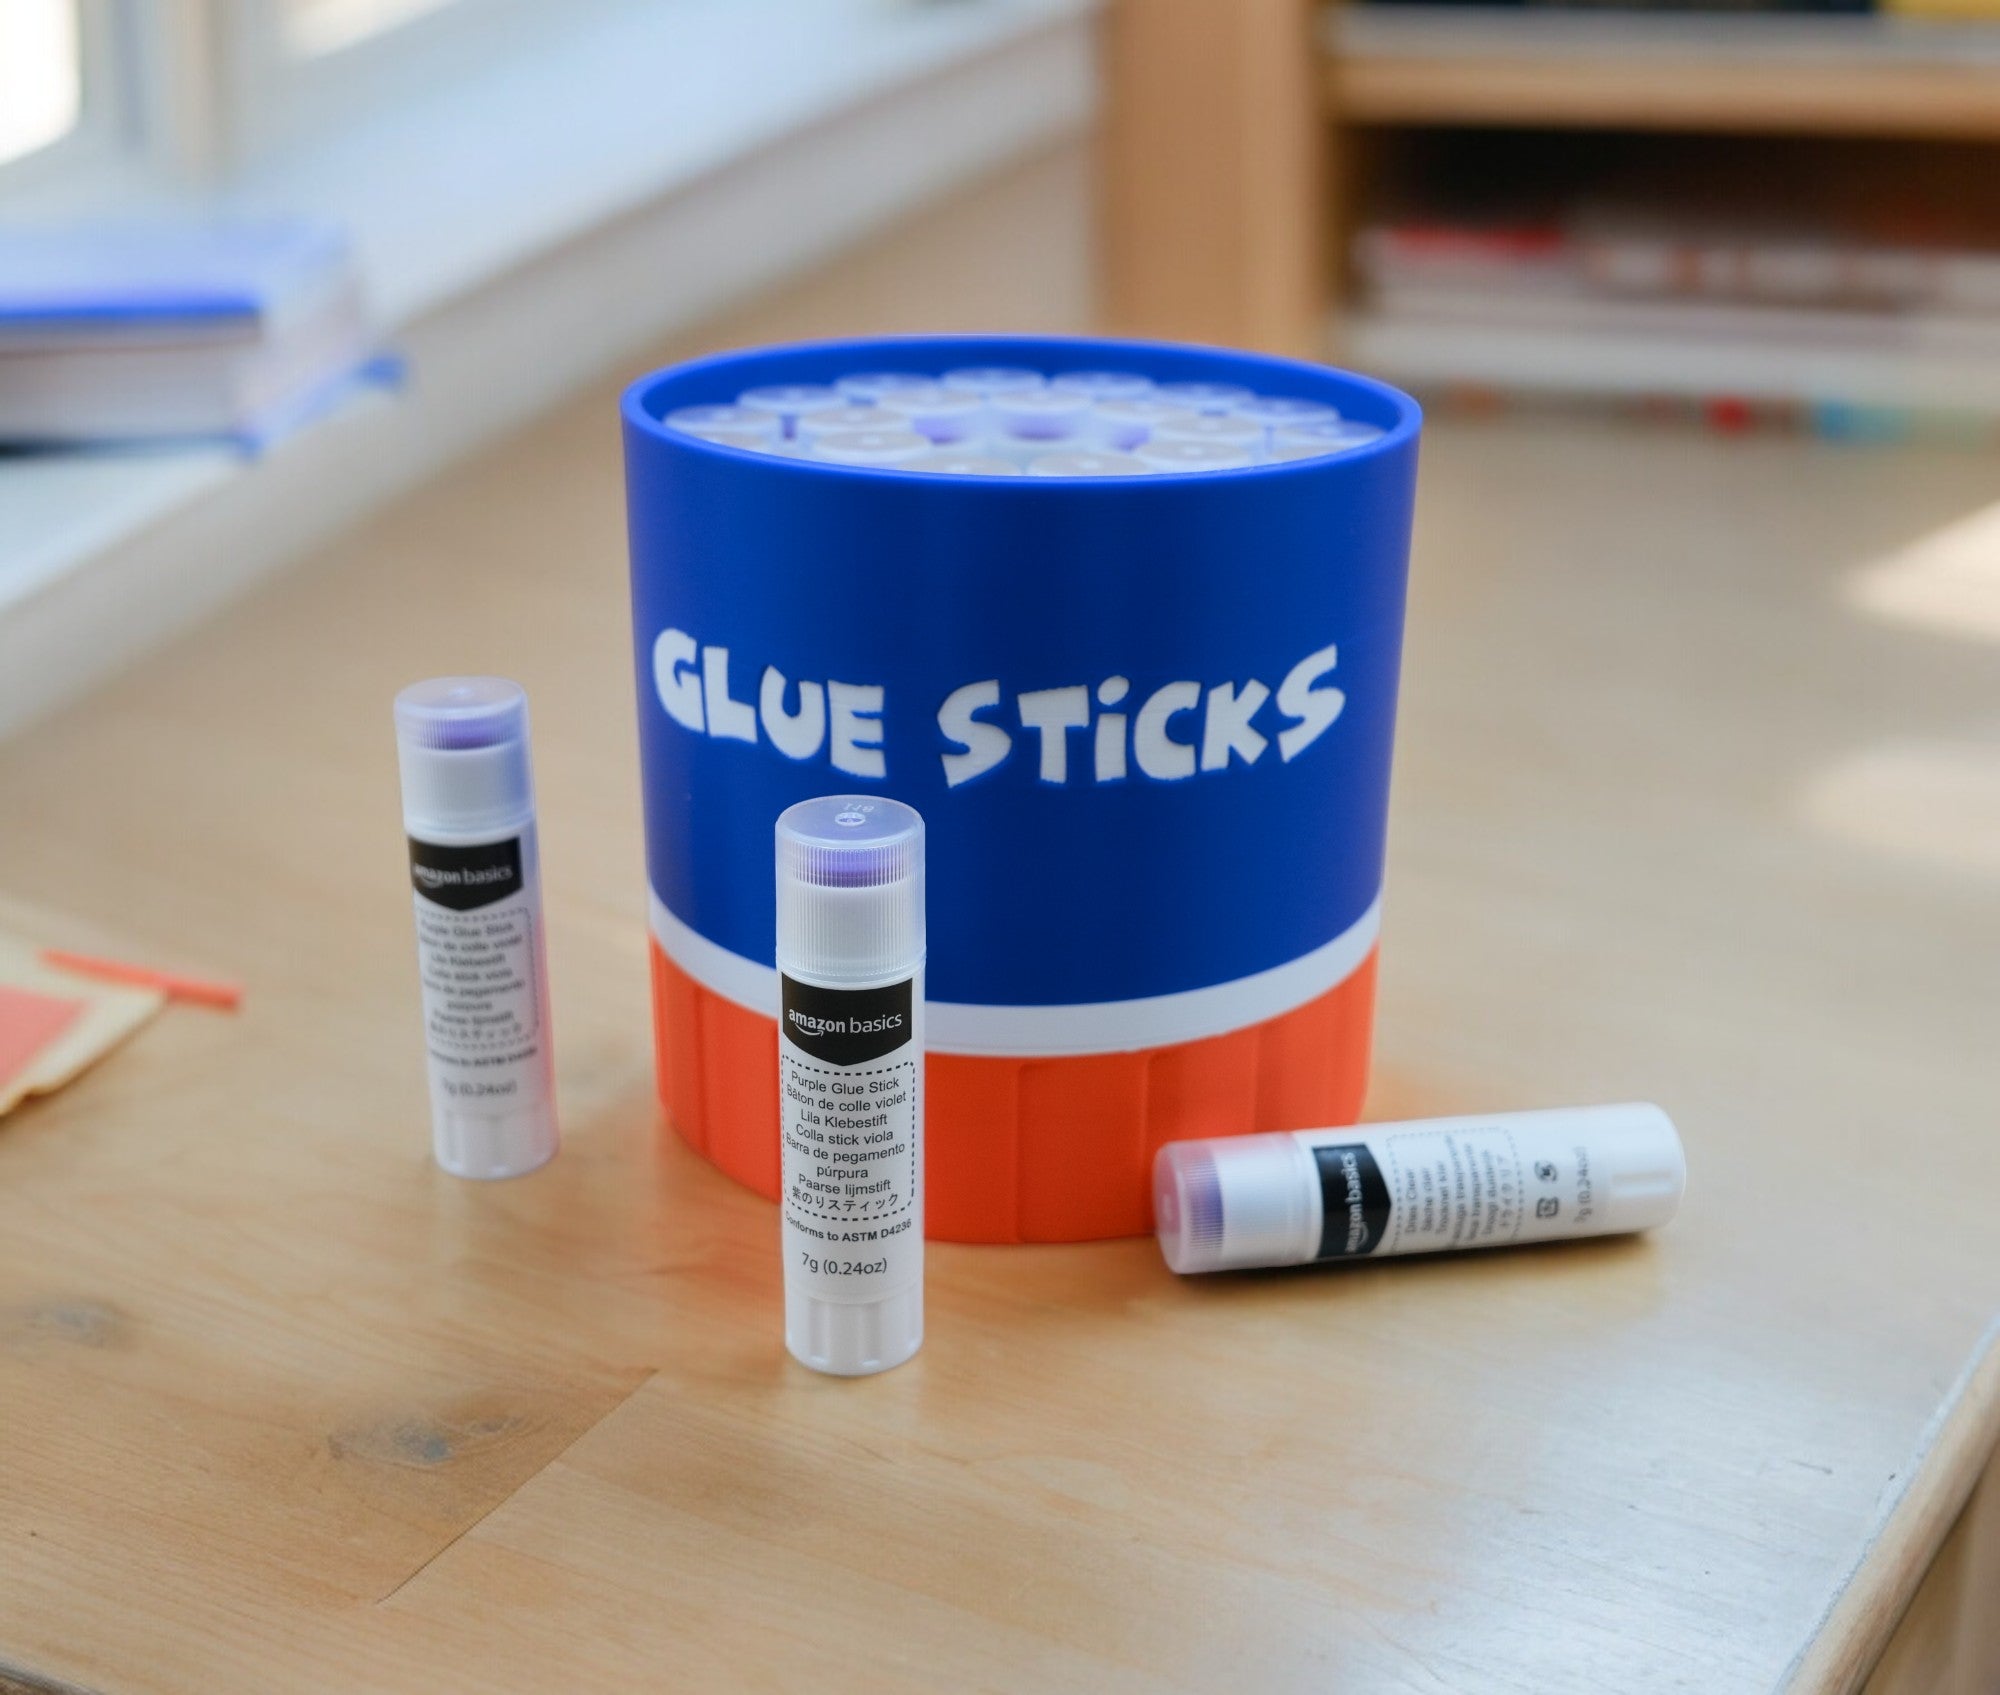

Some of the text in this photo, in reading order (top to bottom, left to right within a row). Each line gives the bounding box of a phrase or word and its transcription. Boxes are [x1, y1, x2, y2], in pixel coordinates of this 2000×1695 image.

[653, 627, 887, 778] GLUE
[414, 862, 513, 888] amazon basics
[788, 1008, 902, 1034] amazon basics
[791, 1070, 900, 1095] Purple Glue Stick
[786, 1084, 907, 1112] Bâton de colle violet
[800, 1109, 888, 1128] Lila Klebestift
[796, 1124, 894, 1146] Colla stick viola
[786, 1133, 906, 1165] Barra de pegamento
[798, 1173, 892, 1198] Paarse lijmstift
[816, 1166, 869, 1181] púrpura
[1341, 1153, 1367, 1253] amazon basics
[827, 1231, 839, 1242] to
[842, 1230, 878, 1242] ASTM
[801, 1252, 888, 1276] 7g (0.24oz)
